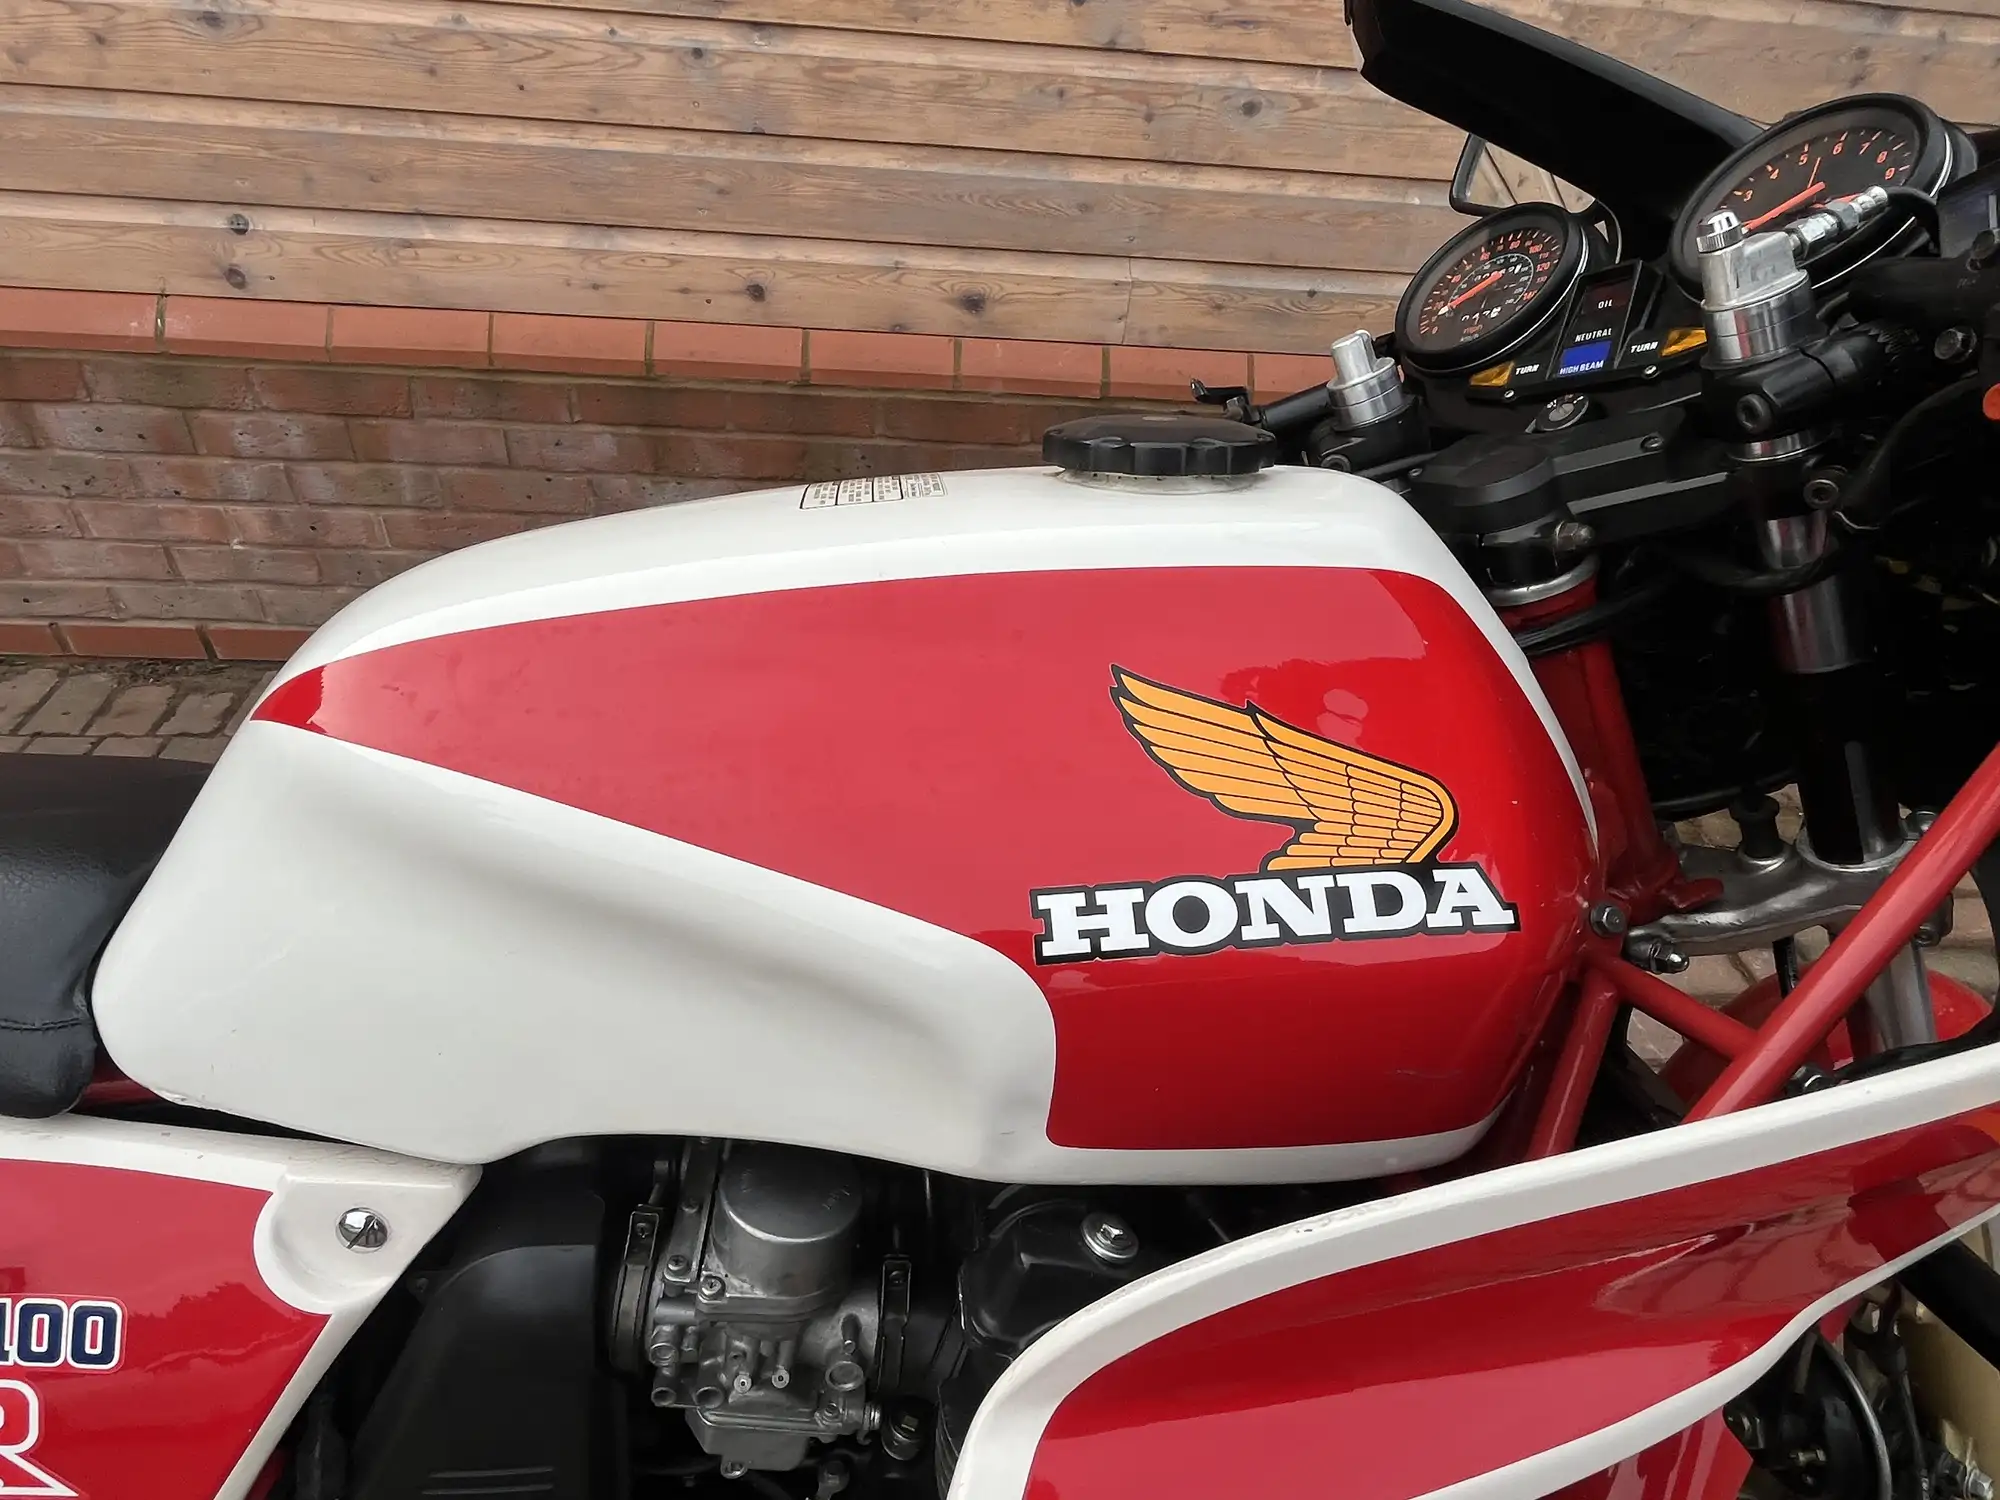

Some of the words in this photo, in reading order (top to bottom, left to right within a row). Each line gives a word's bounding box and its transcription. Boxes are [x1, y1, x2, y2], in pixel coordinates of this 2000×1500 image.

[1832, 142, 1844, 155] 6
[1859, 141, 1872, 155] 7
[1799, 153, 1808, 166] 5
[1876, 151, 1888, 163] 8
[1769, 167, 1780, 180] 4
[1884, 167, 1896, 180] 9
[1743, 189, 1753, 202] 3
[1598, 299, 1613, 309] OIL
[1575, 327, 1612, 343] NEUTRAL
[1630, 341, 1659, 354] TURN
[1515, 363, 1540, 376] TURN
[1559, 365, 1579, 375] HIGH
[1579, 360, 1604, 371] BEAM
[1035, 867, 1517, 958] HONDA
